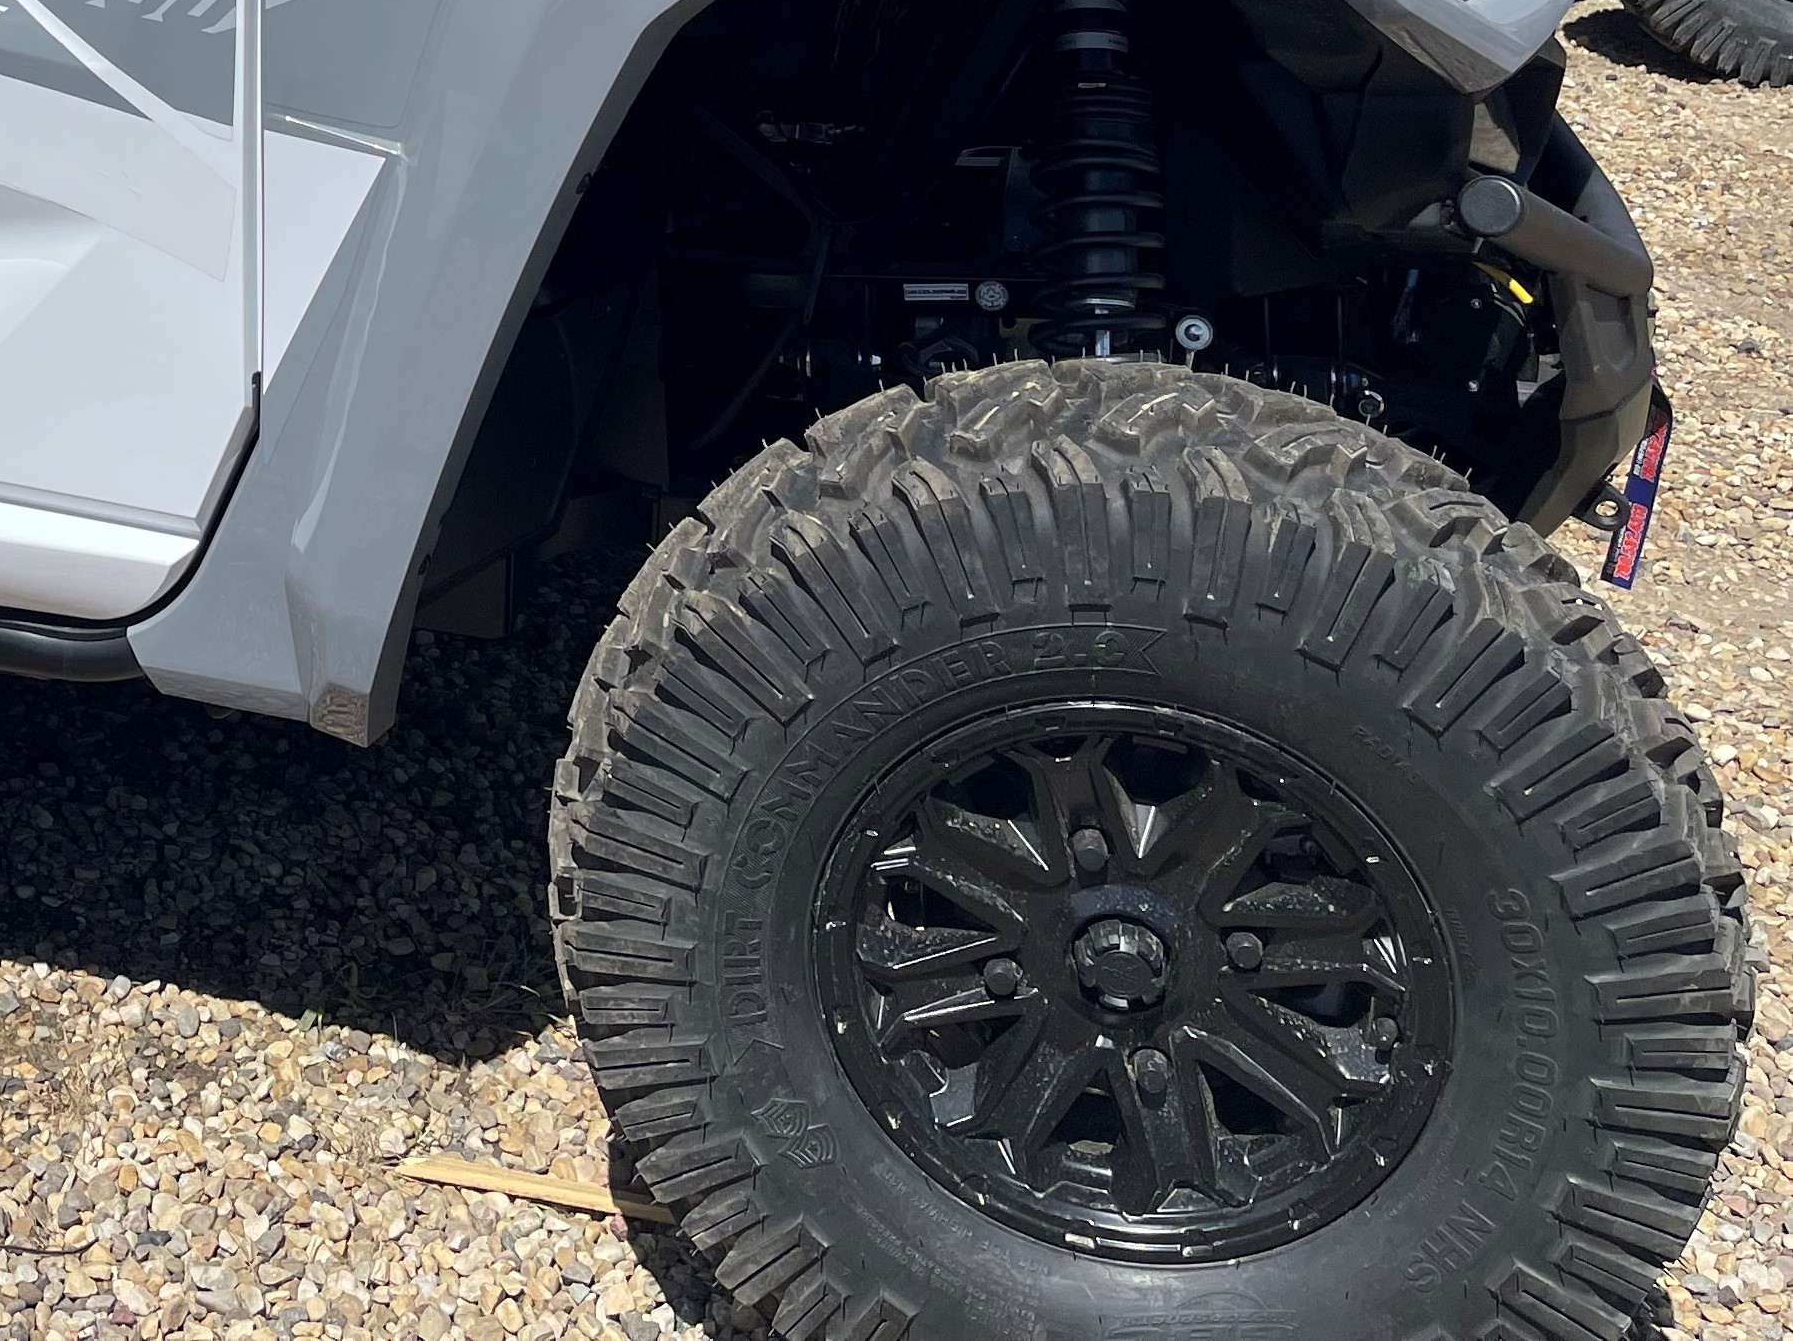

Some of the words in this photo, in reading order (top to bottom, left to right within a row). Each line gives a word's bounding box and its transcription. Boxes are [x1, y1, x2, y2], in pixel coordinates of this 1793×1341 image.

[733, 639, 1013, 889] COMMANDER
[719, 910, 769, 1027] DIRT
[1405, 1199, 1498, 1294] NHS
